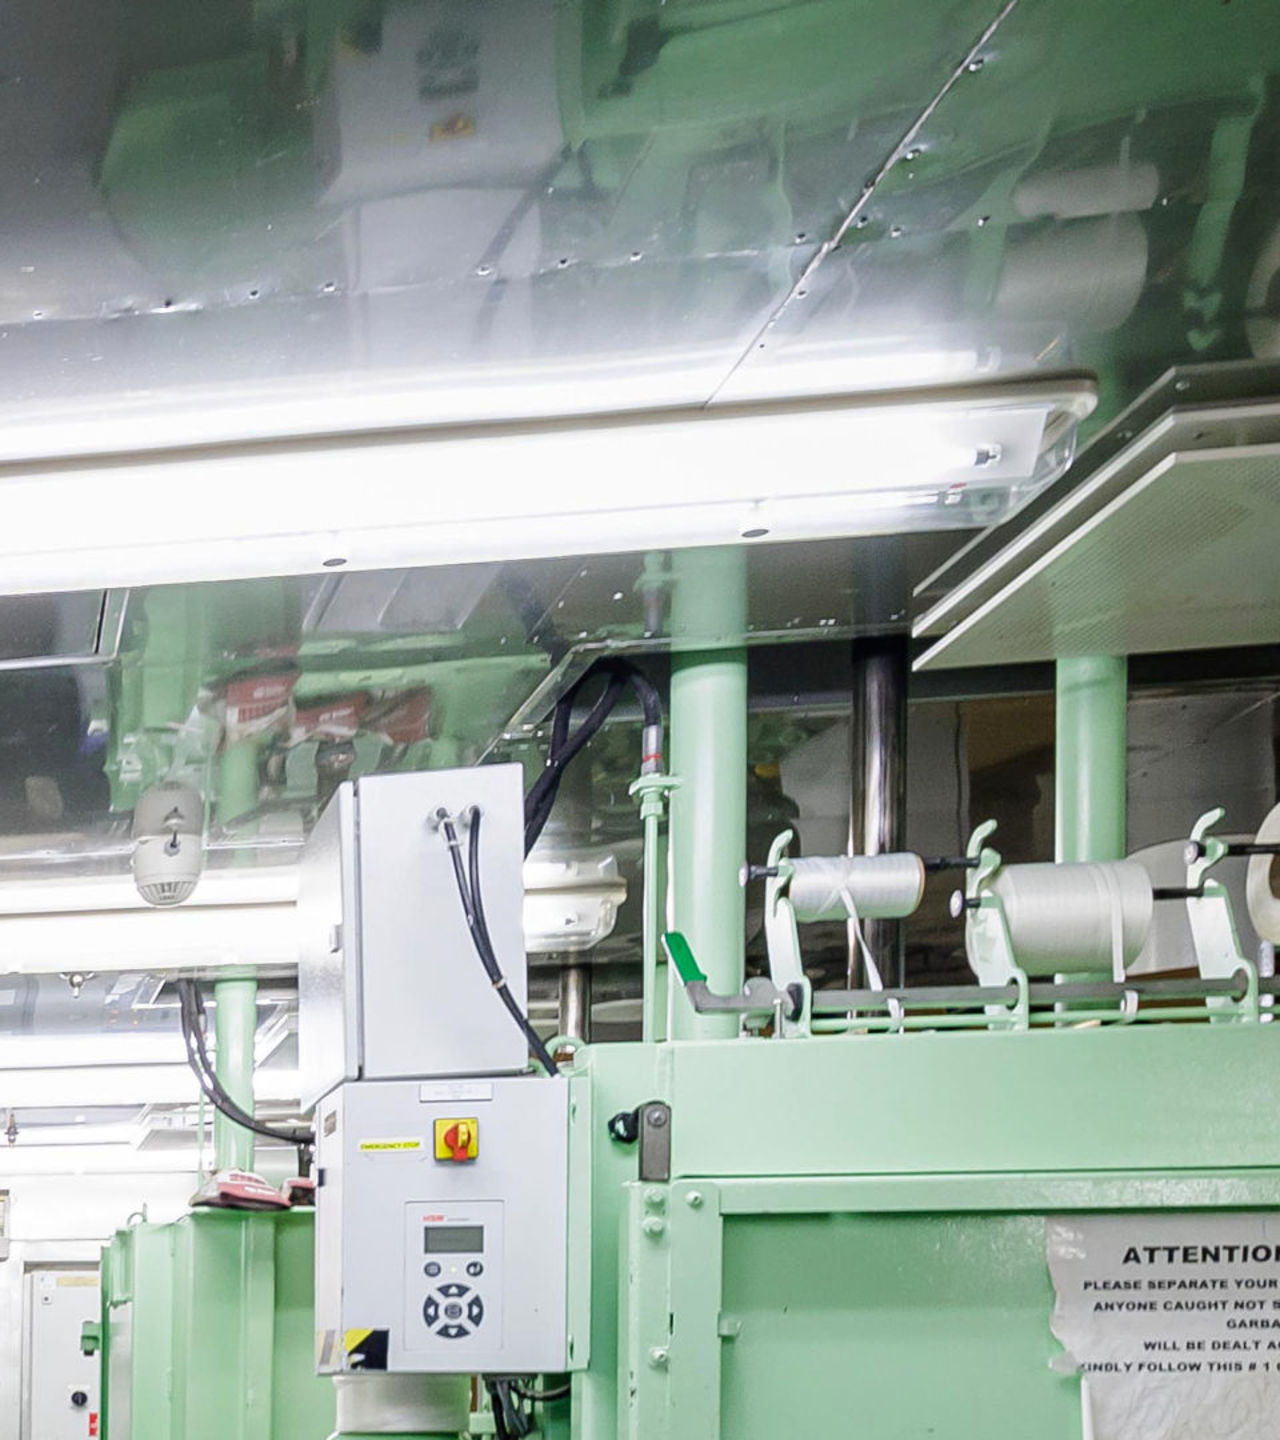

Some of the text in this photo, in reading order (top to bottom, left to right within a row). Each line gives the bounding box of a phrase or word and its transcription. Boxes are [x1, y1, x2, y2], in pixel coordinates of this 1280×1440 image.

[1083, 1278, 1279, 1290] PLEASE SEPARATE YOUR
[1093, 1301, 1157, 1312] ANYONE
[1163, 1300, 1229, 1311] CAUGHT
[1233, 1299, 1266, 1311] NOT
[1143, 1341, 1180, 1351] WILL
[1186, 1340, 1206, 1351] BE
[1211, 1340, 1261, 1351] DEALT
[1138, 1361, 1202, 1373] FOLLOW
[1207, 1361, 1243, 1373] THIS
